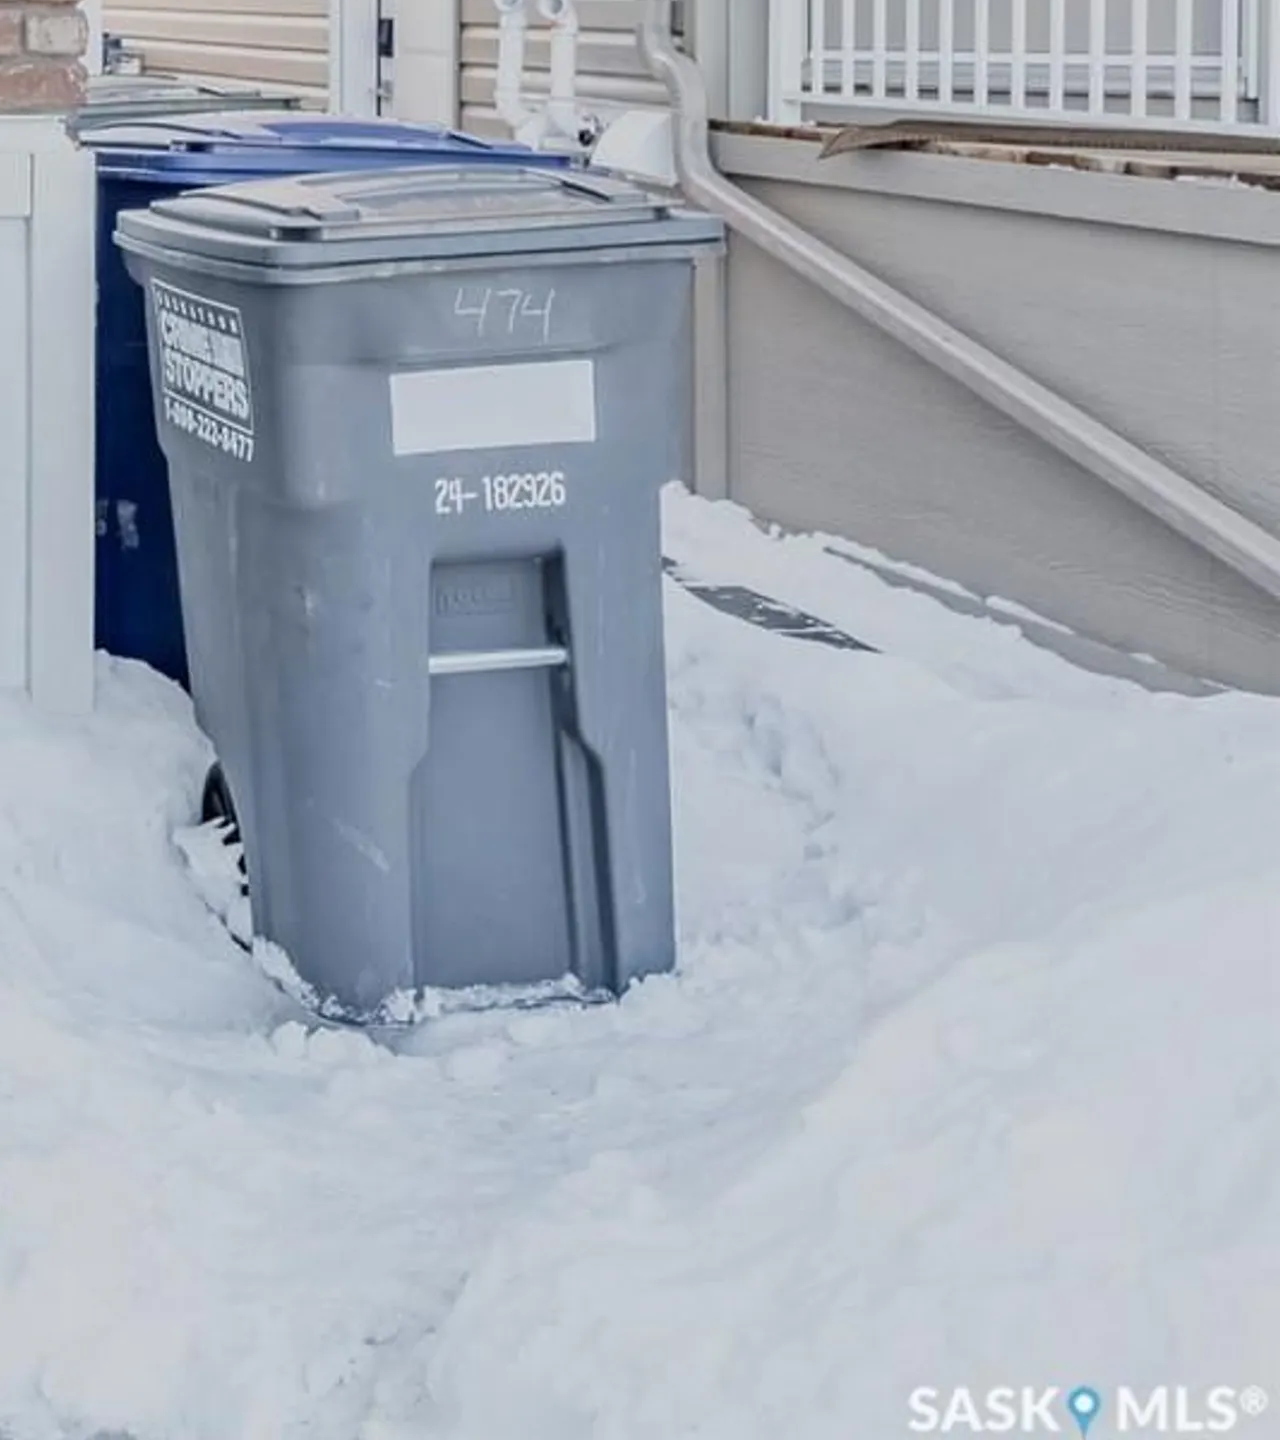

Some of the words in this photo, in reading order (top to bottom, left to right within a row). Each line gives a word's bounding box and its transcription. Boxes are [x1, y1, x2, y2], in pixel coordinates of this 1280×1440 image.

[454, 288, 556, 344] 474
[164, 346, 250, 420] STOPPERS
[435, 471, 567, 514] 24-182926
